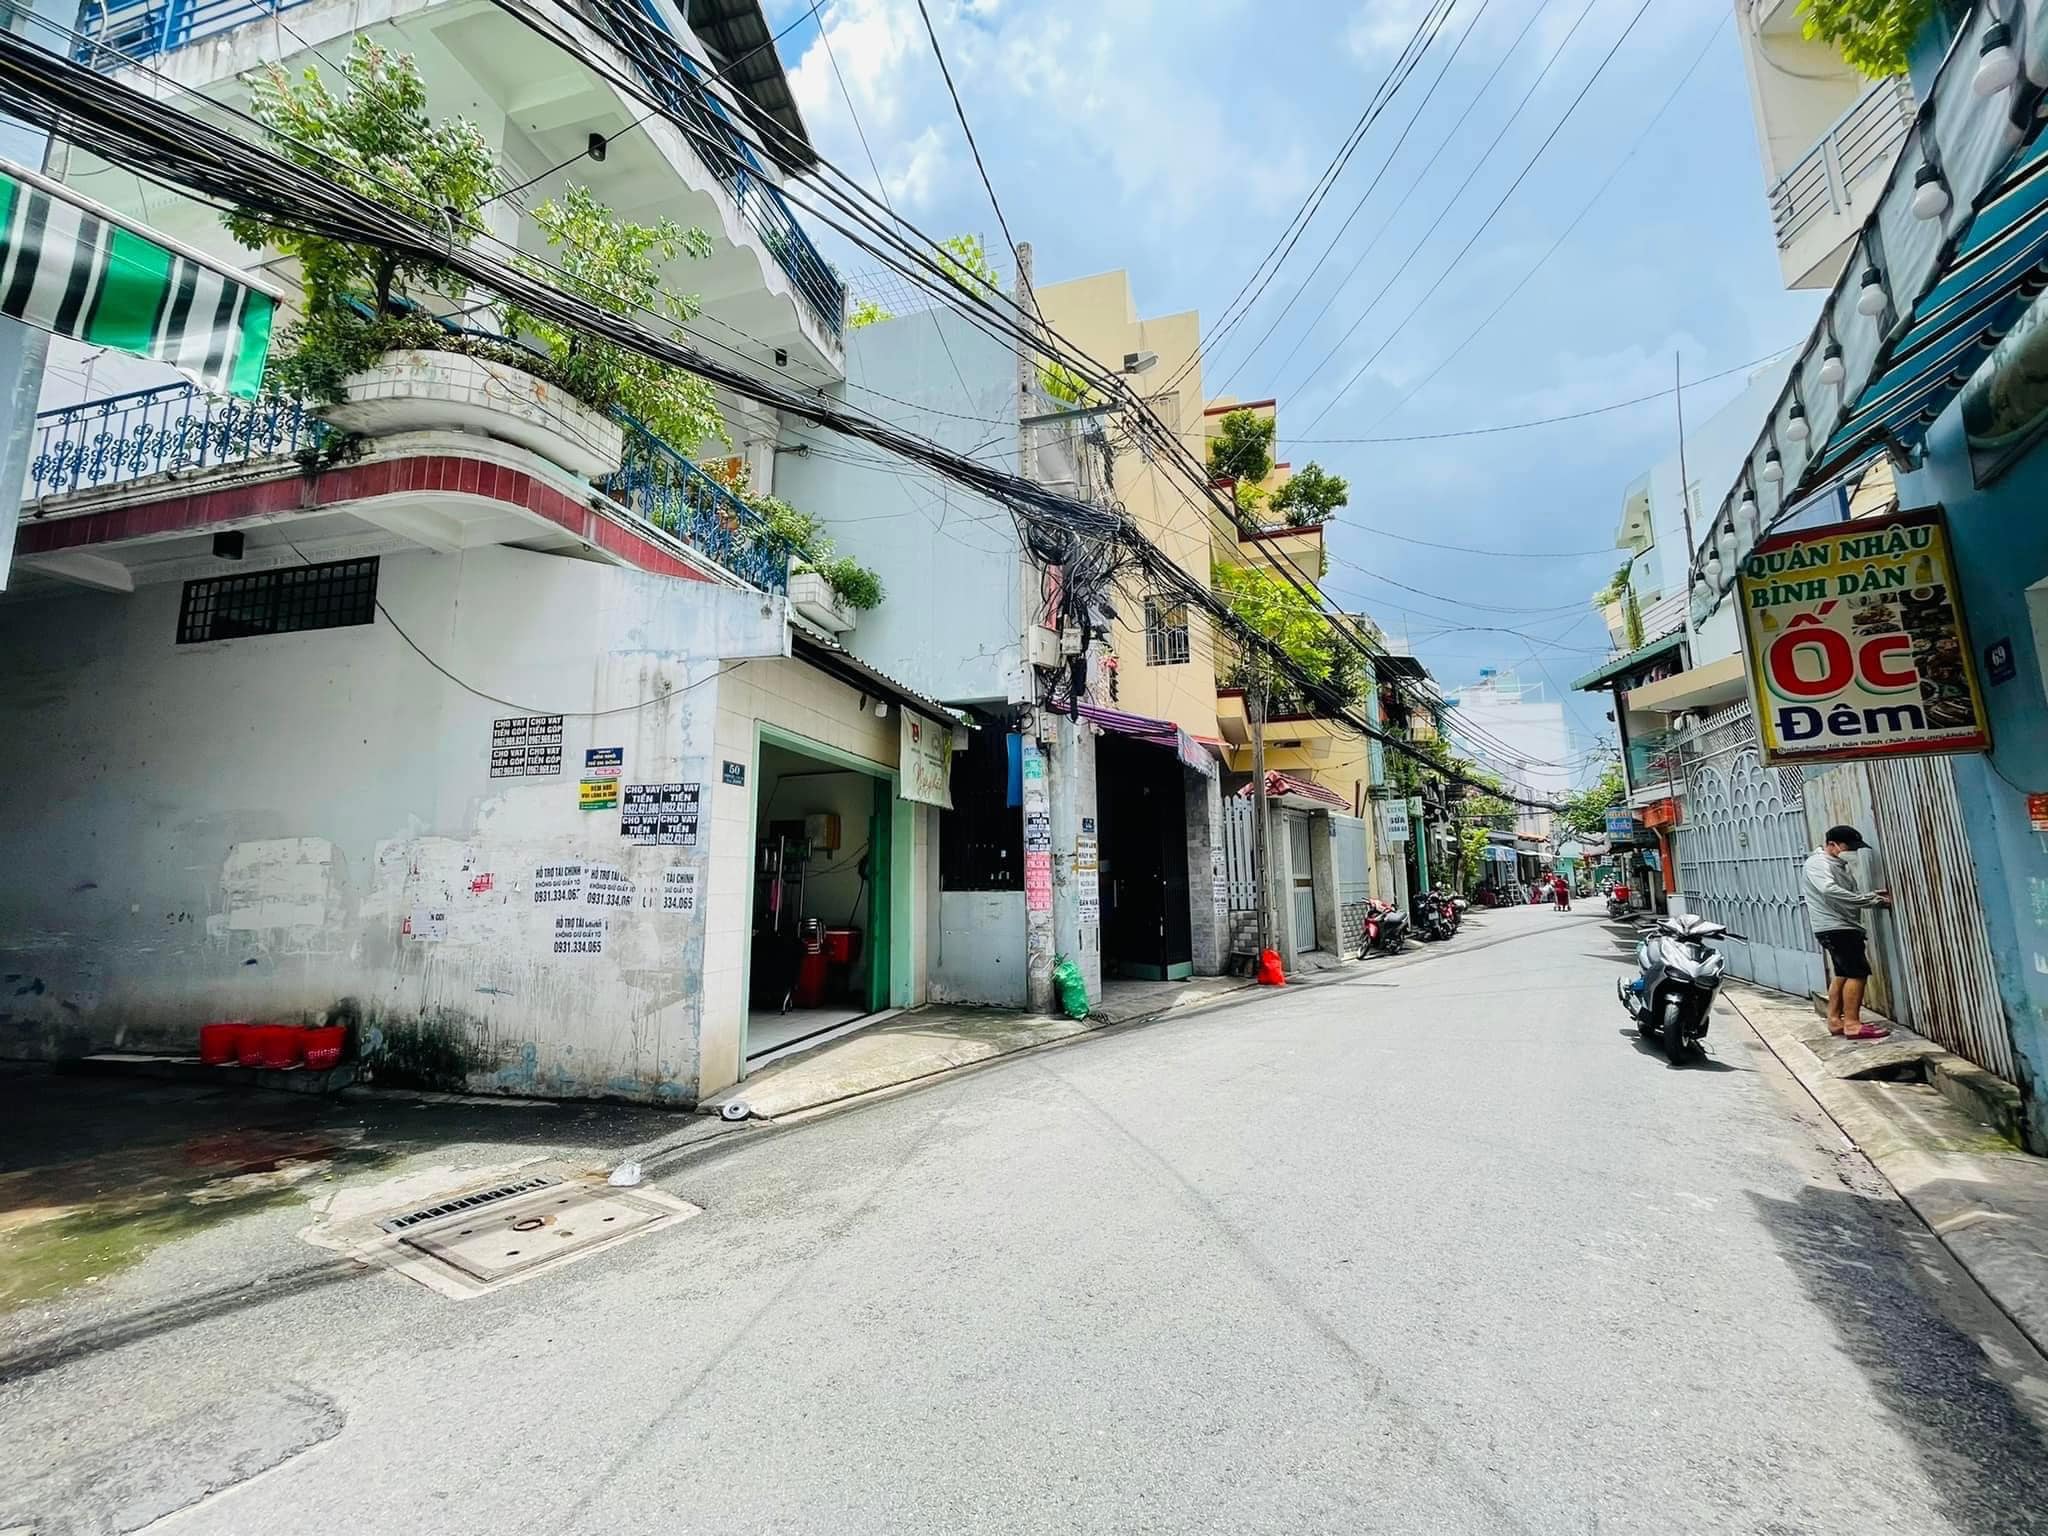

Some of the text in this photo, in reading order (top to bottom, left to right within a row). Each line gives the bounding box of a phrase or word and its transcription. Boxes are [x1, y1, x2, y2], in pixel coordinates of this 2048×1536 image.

[1747, 525, 1931, 580] QUÁN NHẬU
[1751, 563, 1907, 608] BÌNH DÂN
[1992, 646, 2006, 666] 69
[495, 719, 525, 729] CHO VAY
[530, 716, 561, 727] CHO VAY
[1775, 703, 1925, 741] Đêm
[493, 749, 524, 758] CHO VAY
[529, 746, 560, 756] CHO VAY
[625, 785, 661, 794] CHO VAY
[663, 784, 699, 793] CHO VAY
[622, 815, 658, 825] CHO VAY
[660, 815, 697, 824] CHO VAY
[554, 941, 602, 953] 0931.334.065
